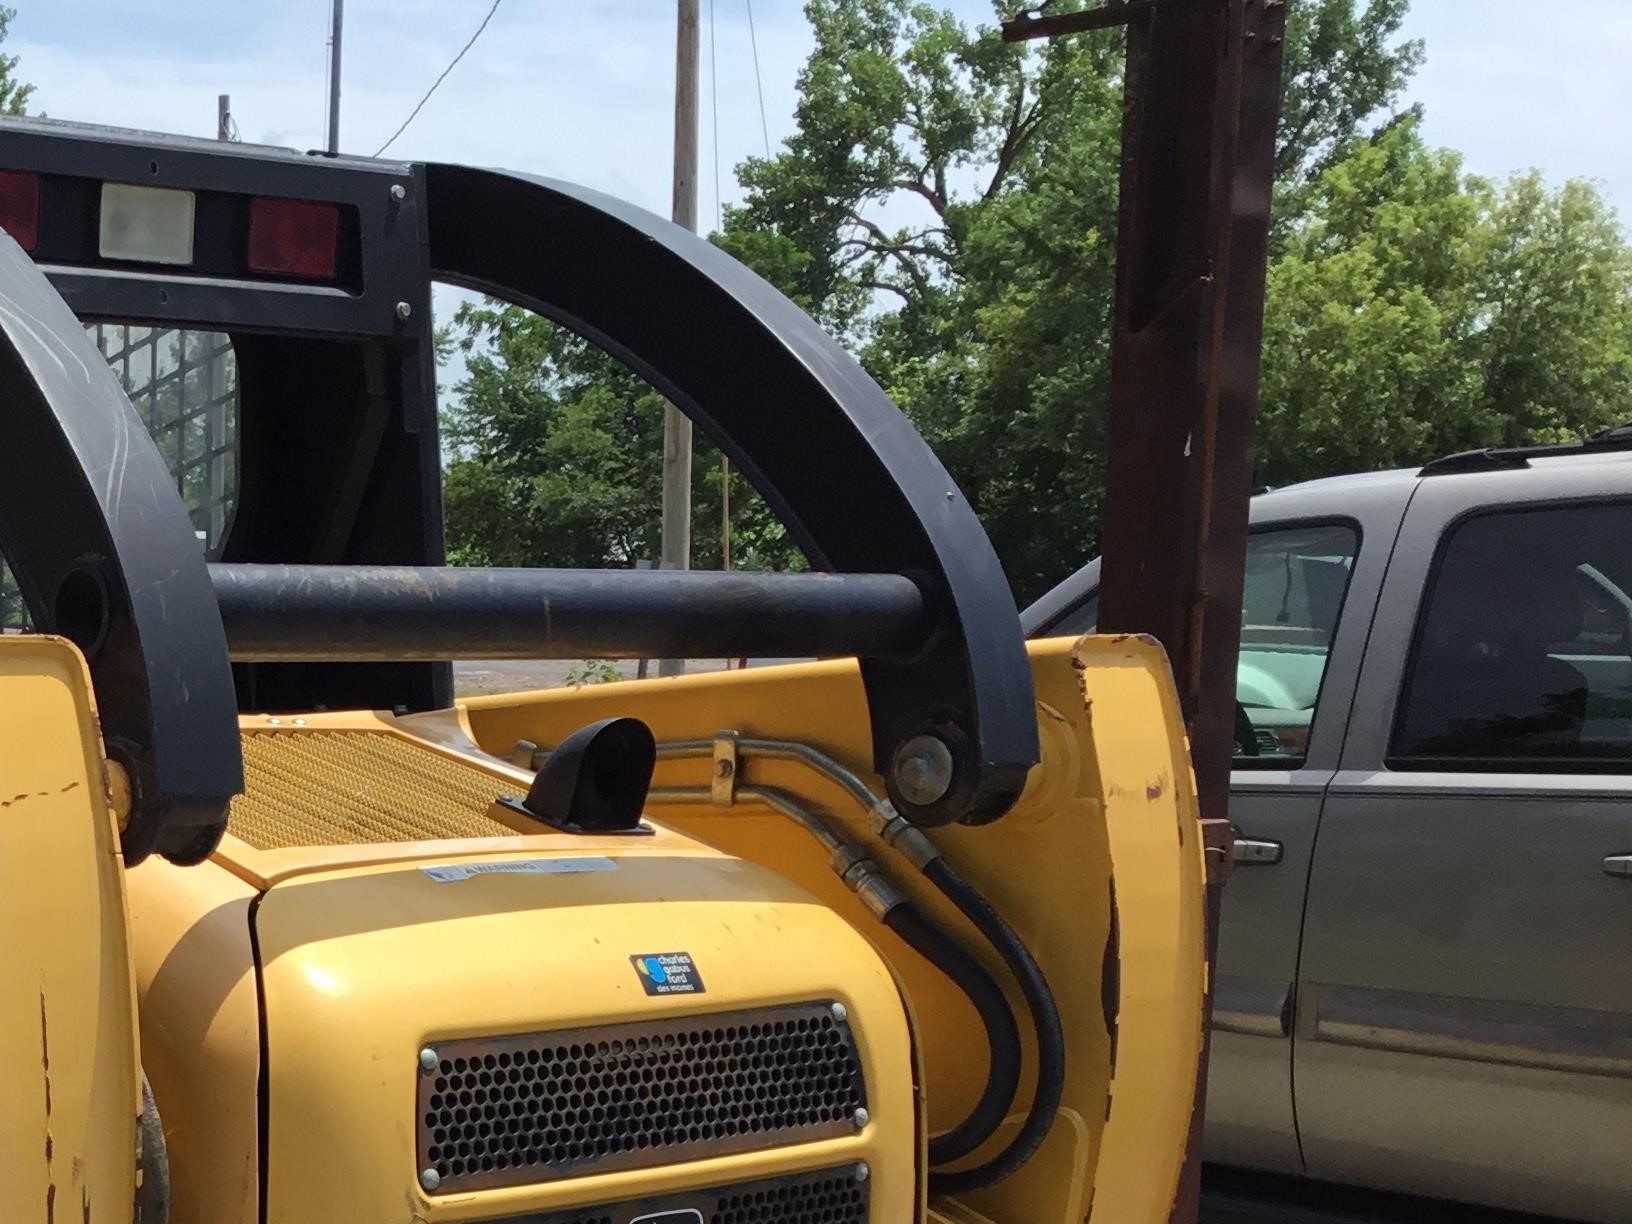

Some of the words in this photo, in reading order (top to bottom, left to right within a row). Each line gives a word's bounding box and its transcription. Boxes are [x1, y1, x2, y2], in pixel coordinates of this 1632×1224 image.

[472, 862, 537, 874] WARNING
[657, 954, 690, 965] charles
[662, 964, 692, 975] gabus
[666, 973, 688, 984] ford
[656, 984, 670, 993] des
[670, 983, 695, 992] moines
